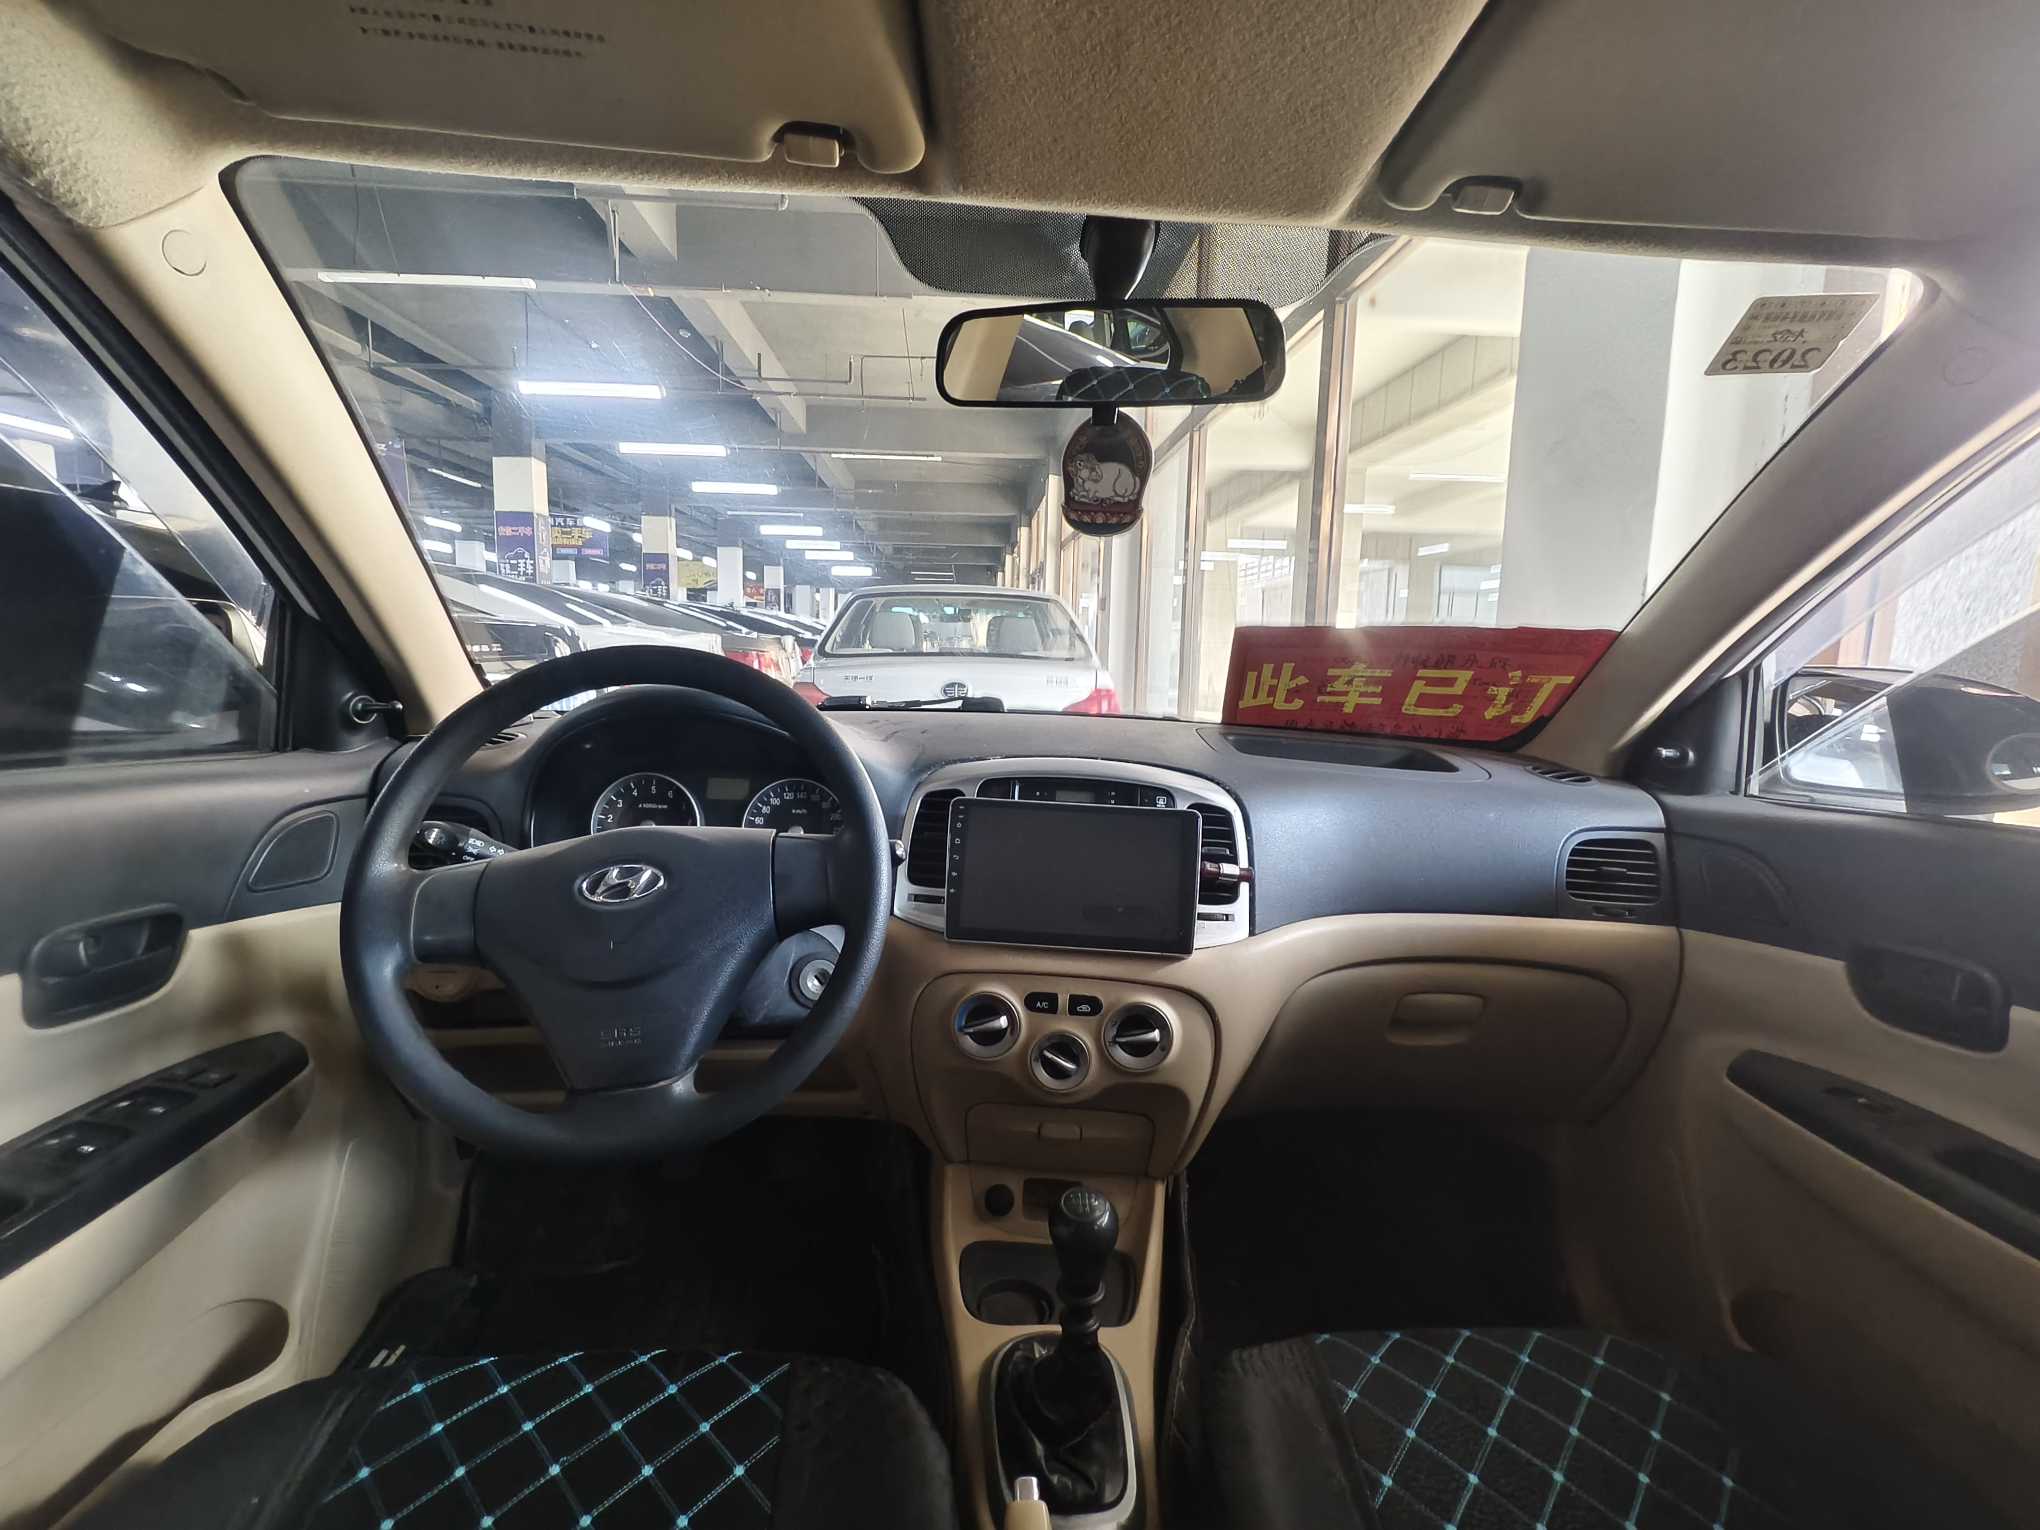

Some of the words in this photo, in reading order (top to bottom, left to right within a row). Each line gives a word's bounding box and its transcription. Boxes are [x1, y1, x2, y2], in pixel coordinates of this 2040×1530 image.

[1238, 662, 1575, 724] 此车已订
[632, 788, 638, 796] 4
[651, 785, 656, 794] 5
[783, 792, 794, 800] 120
[770, 798, 781, 806] 100
[607, 814, 613, 822] 2
[754, 816, 764, 825] 60
